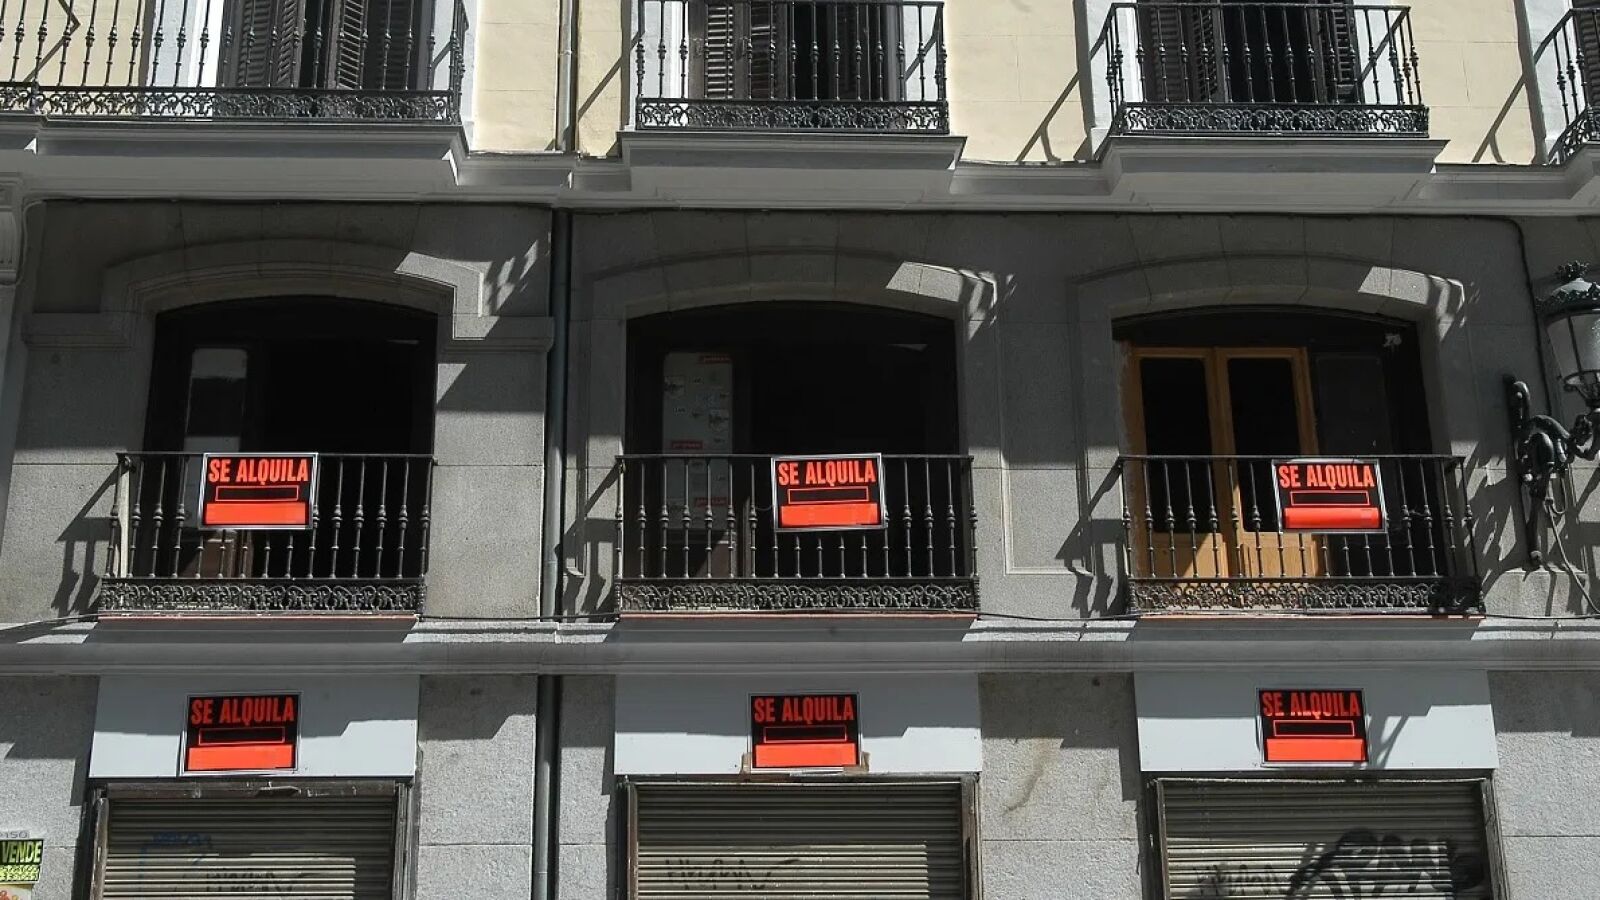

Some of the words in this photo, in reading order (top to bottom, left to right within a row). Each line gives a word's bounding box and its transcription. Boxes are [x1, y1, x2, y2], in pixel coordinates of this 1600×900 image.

[208, 458, 231, 482] SE
[236, 458, 309, 486] ALQUILA
[777, 462, 799, 485] SE
[804, 460, 876, 487] ALQUILA
[1278, 465, 1300, 487] SE
[1305, 465, 1375, 489] ALQUILA
[191, 699, 213, 724] SE
[220, 698, 294, 725] ALQUILA
[753, 698, 774, 721] SE
[782, 698, 854, 724] ALQUILA
[1262, 692, 1283, 716] SE
[1290, 692, 1362, 719] ALQUILA
[2, 841, 42, 863] VENDE
